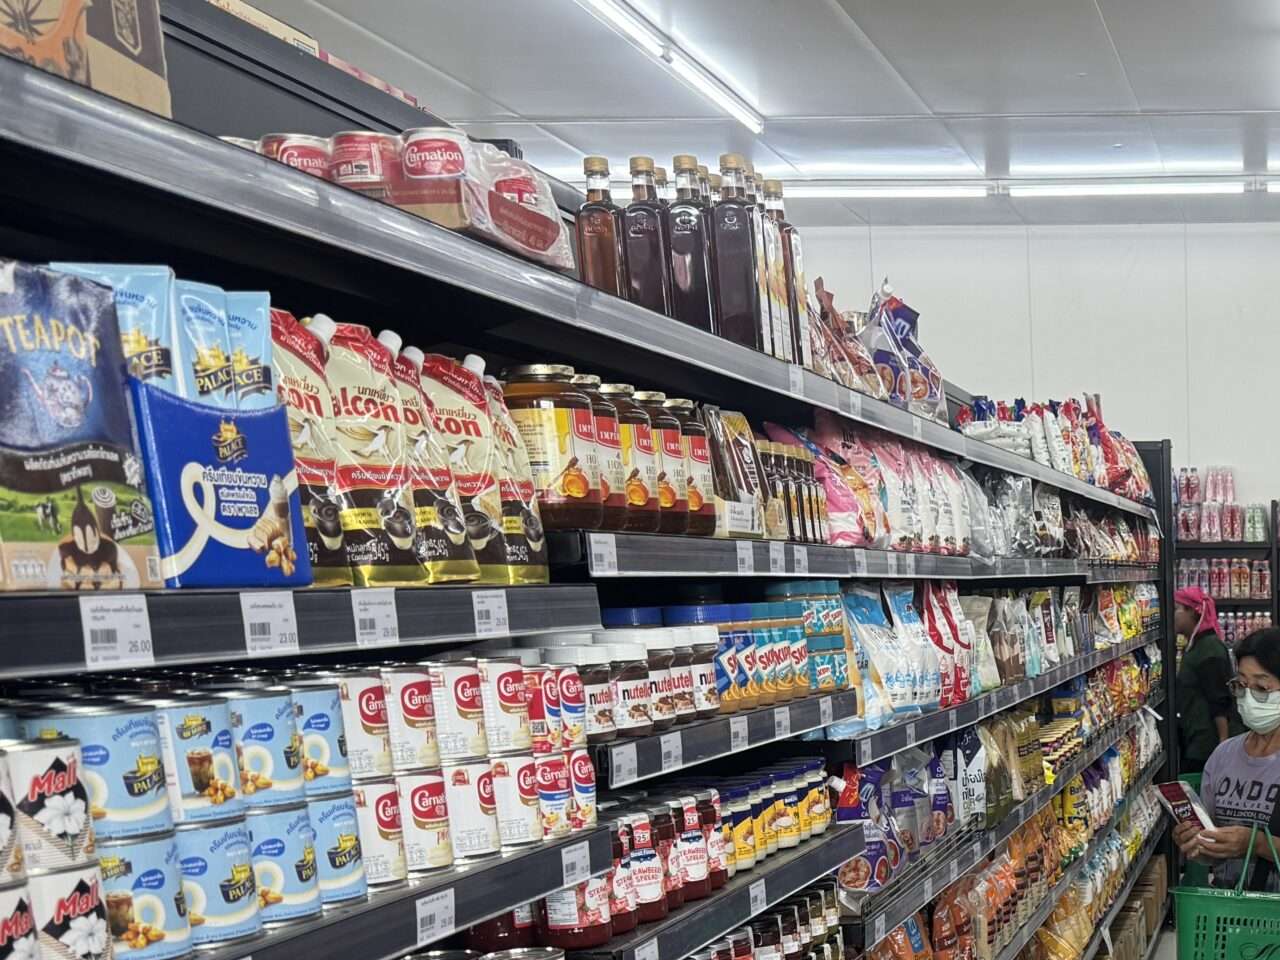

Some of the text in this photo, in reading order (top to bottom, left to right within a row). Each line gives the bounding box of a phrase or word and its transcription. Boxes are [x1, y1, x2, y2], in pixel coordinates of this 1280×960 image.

[405, 146, 463, 168] Carnation
[0, 314, 101, 368] TEAPOT
[198, 366, 233, 391] PALAC
[29, 750, 78, 801] Mali
